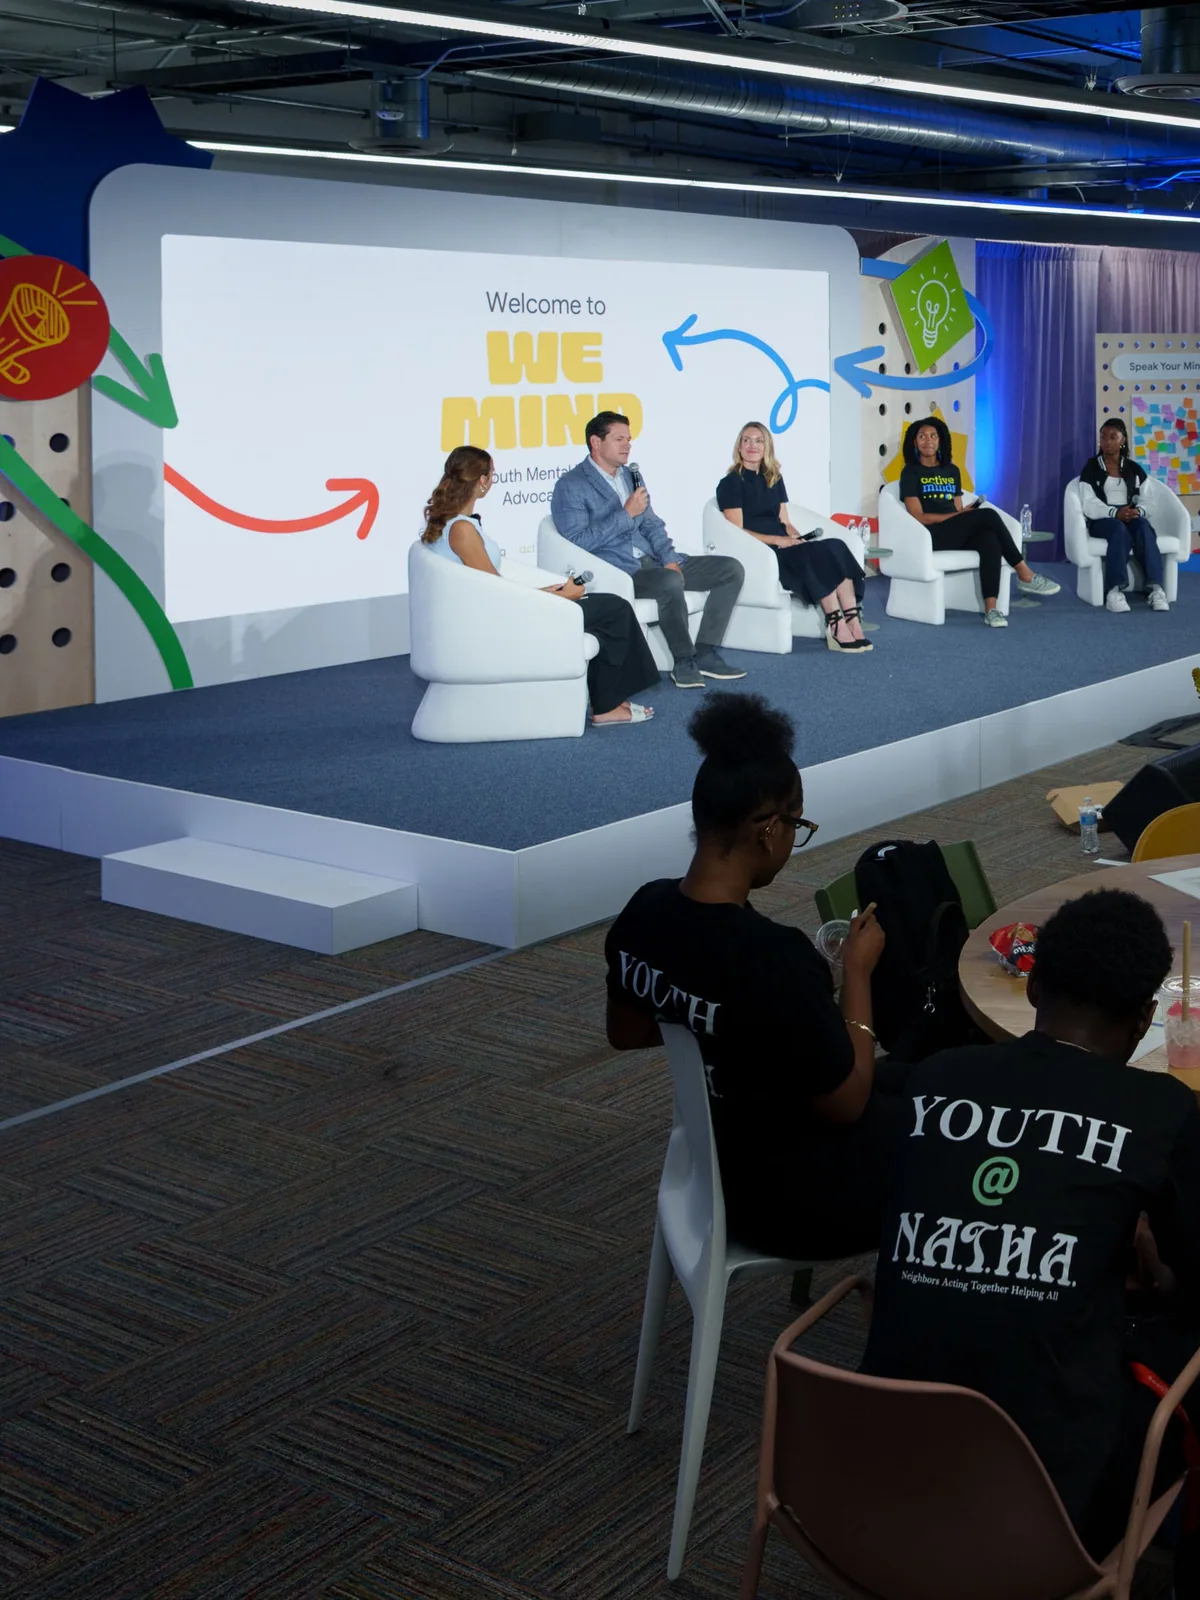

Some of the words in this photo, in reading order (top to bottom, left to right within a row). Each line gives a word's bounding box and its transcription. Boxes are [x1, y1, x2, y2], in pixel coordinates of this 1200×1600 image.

[486, 291, 581, 315] Welcome
[586, 296, 606, 315] to
[486, 330, 603, 385] WE
[1129, 362, 1159, 373] Speak
[1160, 361, 1181, 371] Your
[441, 392, 643, 453] MIND
[492, 468, 522, 484] outh
[920, 475, 955, 485] active
[922, 483, 957, 493] minds
[502, 490, 554, 506] Advoca
[618, 949, 722, 1037] YOUTH
[908, 1094, 1133, 1173] YOUTH
[971, 1155, 1020, 1207] @
[891, 1211, 1079, 1288] N.A.T.H.A.
[901, 1270, 940, 1286] Neighbors
[941, 1277, 968, 1292] Acting
[970, 1280, 1009, 1295] Together
[1011, 1285, 1045, 1301] Helping
[1046, 1290, 1059, 1301] All
